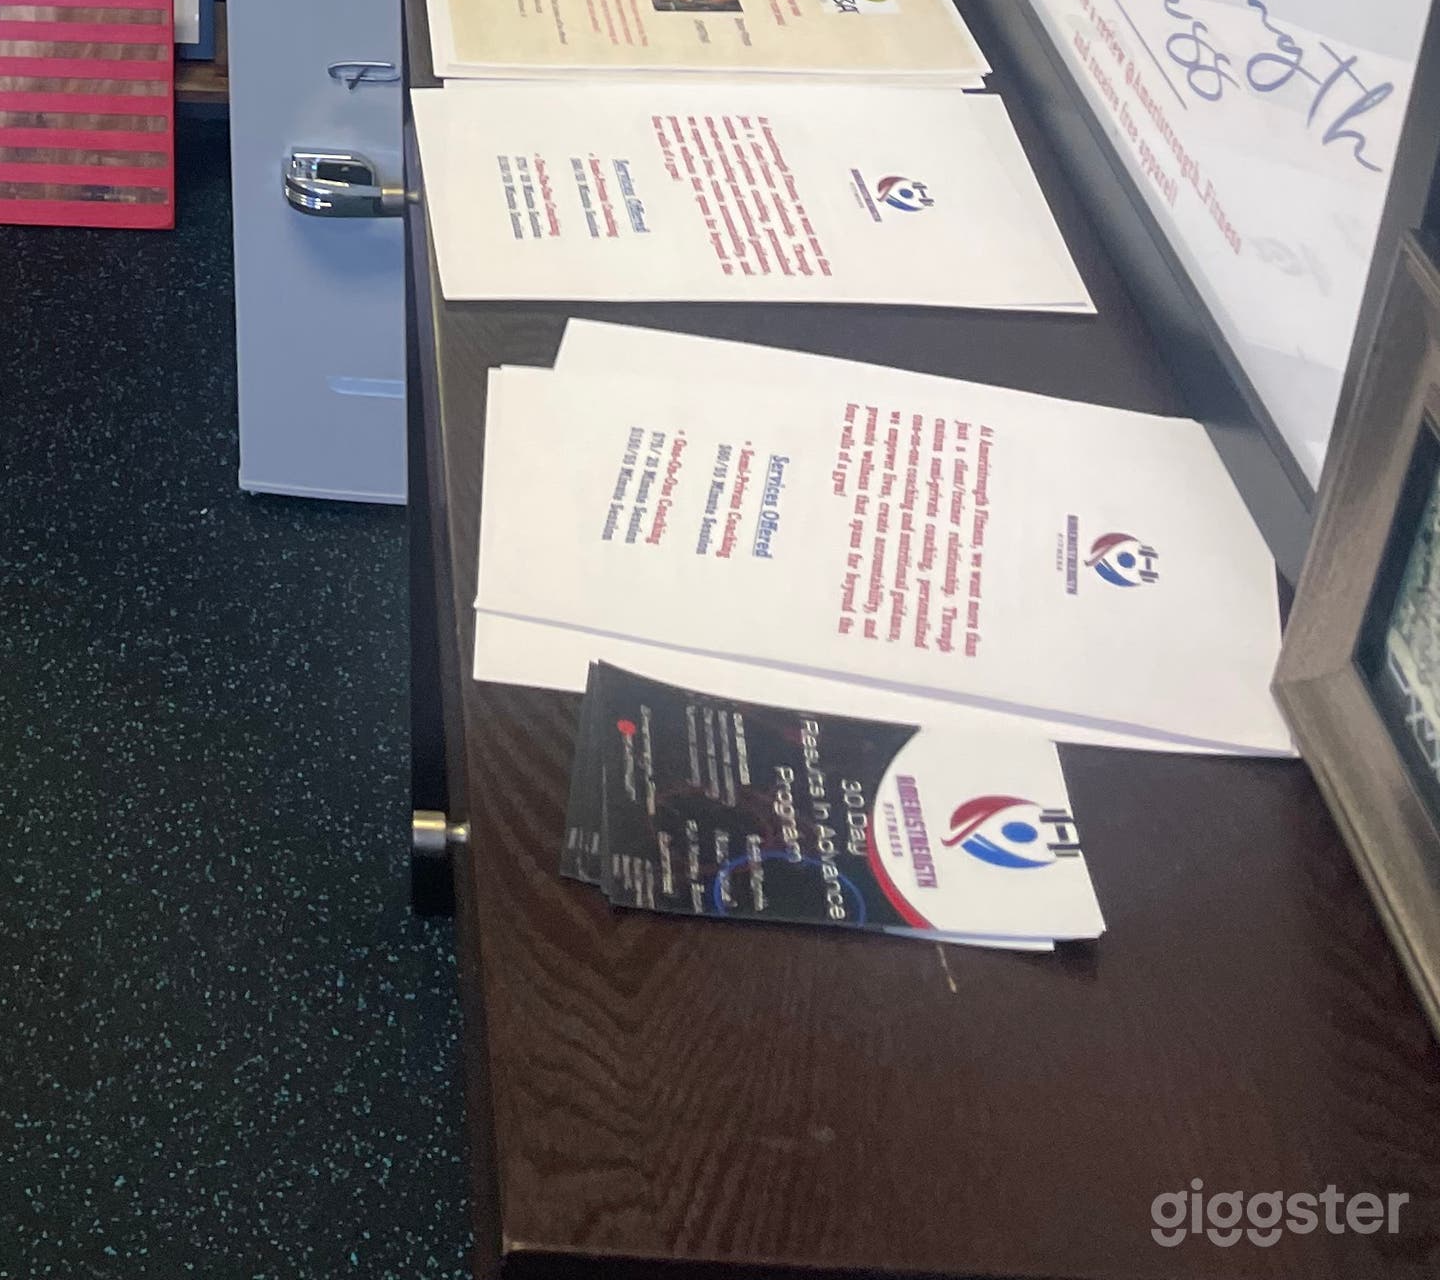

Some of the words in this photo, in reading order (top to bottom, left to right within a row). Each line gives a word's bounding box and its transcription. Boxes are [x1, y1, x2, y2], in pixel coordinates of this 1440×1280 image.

[763, 454, 790, 508] Services
[753, 509, 781, 559] Offered
[798, 718, 830, 799] Results
[768, 764, 806, 863] Program
[811, 801, 833, 821] In
[840, 778, 865, 809] 30
[842, 810, 874, 857] Day
[814, 824, 849, 920] Advance
